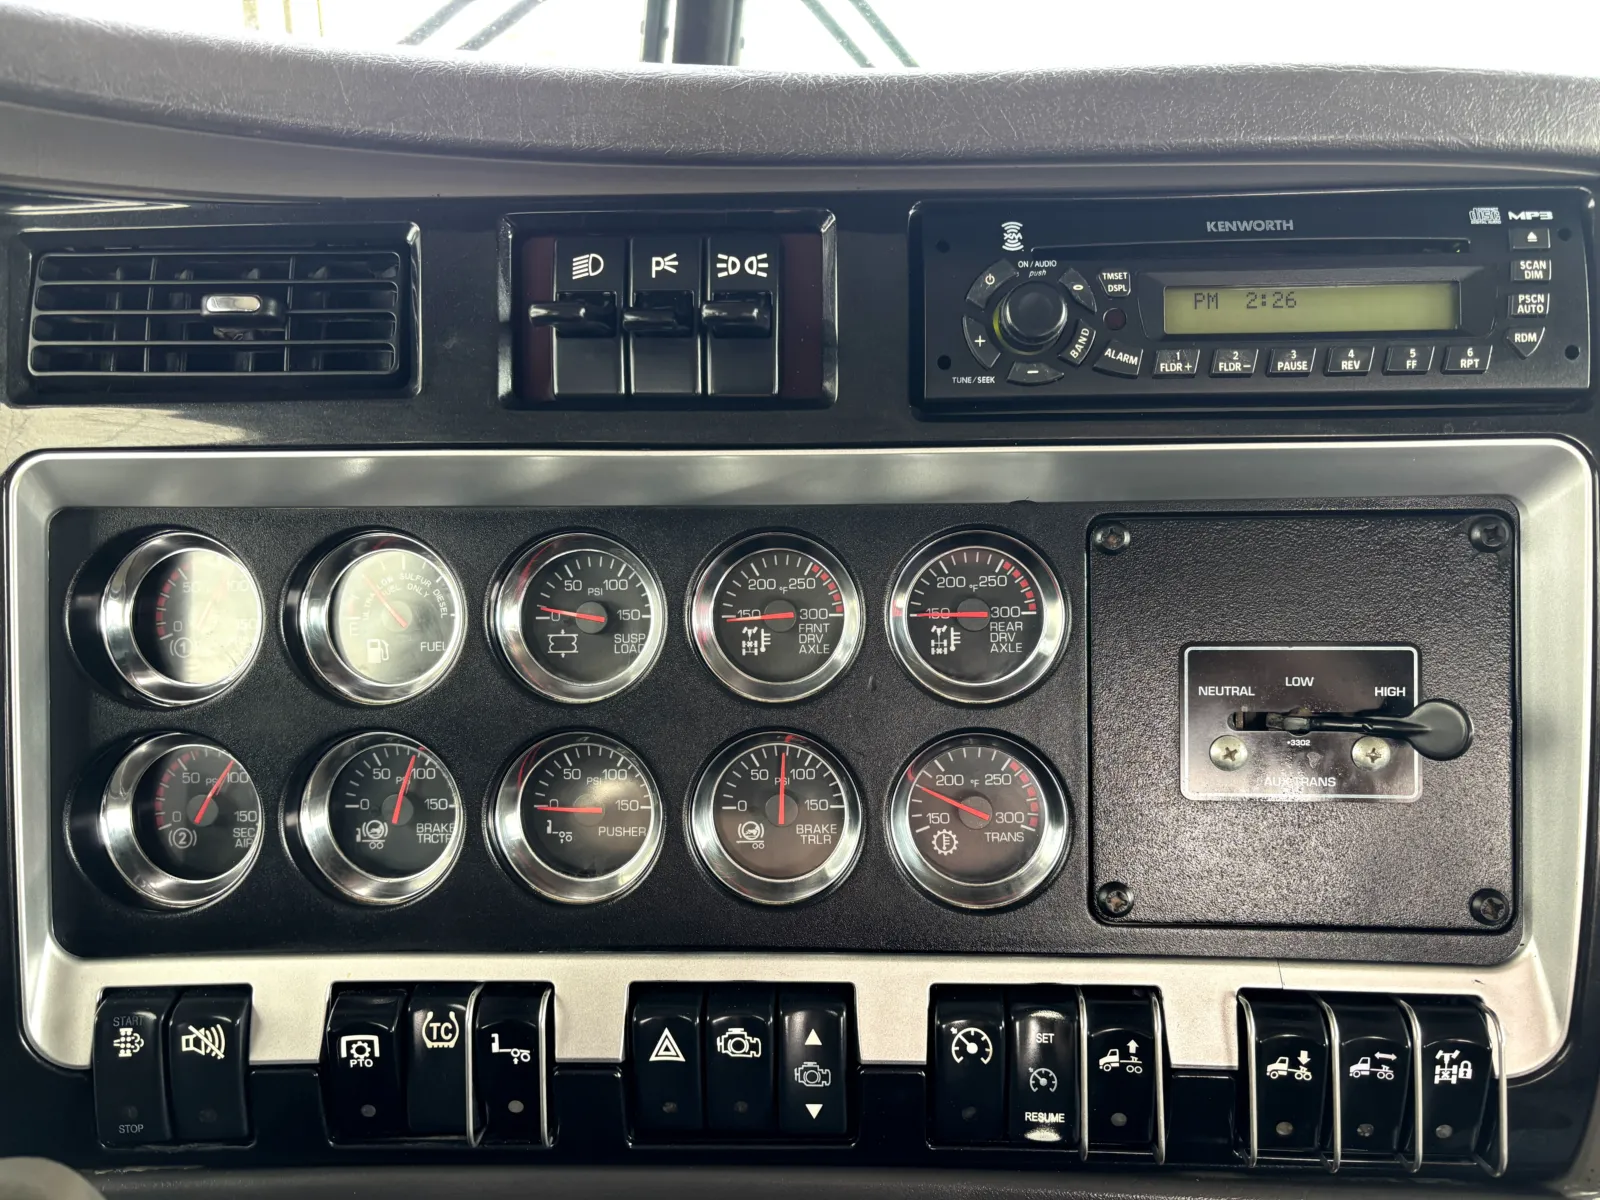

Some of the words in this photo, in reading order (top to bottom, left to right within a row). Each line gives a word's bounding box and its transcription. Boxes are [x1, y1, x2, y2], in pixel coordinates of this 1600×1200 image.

[1508, 211, 1553, 220] MP3
[1206, 219, 1294, 232] KENWORTH
[1017, 260, 1029, 268] ON
[1034, 260, 1057, 268] AUDIO
[1520, 260, 1547, 270] SCAN
[1028, 269, 1047, 278] push
[1102, 272, 1128, 280] TMSET
[1524, 270, 1544, 279] DIM
[1107, 284, 1128, 292] DSPL
[1194, 292, 1219, 310] PM
[1246, 291, 1297, 309] 2:26
[1518, 294, 1545, 303] PSCN
[1517, 304, 1544, 314] AUTO
[1069, 327, 1090, 359] BAND
[1514, 333, 1537, 343] RDM
[1104, 348, 1139, 366] ALARM
[1175, 351, 1181, 360] 1
[1232, 351, 1239, 360] 2
[1290, 350, 1297, 359] 3
[1348, 349, 1355, 358] 4
[1409, 348, 1416, 358] 5
[1467, 348, 1474, 357] 6
[1277, 361, 1308, 371] PAUSE
[1341, 360, 1361, 370] REV
[1406, 360, 1417, 370] FF
[1459, 358, 1480, 369] RPT
[564, 579, 583, 591] 50
[603, 579, 629, 591] 100
[748, 579, 776, 590] 200
[788, 578, 816, 590] 250
[936, 576, 966, 588] 200
[978, 575, 1008, 587] 250
[399, 573, 432, 588] SULFUR
[432, 589, 448, 618] DIESEL
[407, 583, 431, 598] ONLY
[587, 588, 604, 596] PSI
[616, 609, 641, 621] 150
[799, 608, 829, 620] 300
[990, 606, 1021, 618] 300
[798, 623, 830, 633] FRNT
[989, 621, 1023, 632] REAR
[614, 633, 646, 644] SUSP
[798, 634, 824, 644] DRV
[989, 632, 1016, 643] DRV
[420, 641, 447, 652] FUEL
[798, 644, 830, 654] AXLE
[990, 643, 1023, 653] AXLE
[1285, 676, 1315, 687] LOW
[1198, 686, 1255, 697] NEUTRAL
[1374, 686, 1406, 697] HIGH
[182, 772, 200, 784] 50
[226, 771, 249, 783] 100
[372, 768, 391, 780] 50
[411, 767, 436, 780] 100
[563, 768, 582, 780] 50
[602, 768, 628, 781] 100
[750, 768, 769, 781] 50
[789, 768, 816, 780] 100
[586, 776, 602, 785] PSI
[935, 774, 965, 786] 200
[984, 774, 1012, 786] 250
[360, 799, 370, 810] 0
[424, 799, 448, 811] 150
[615, 799, 639, 811] 150
[737, 800, 748, 812] 0
[804, 799, 829, 811] 150
[172, 811, 182, 822] 0
[234, 810, 258, 822] 150
[926, 812, 950, 824] 150
[995, 811, 1025, 824] 300
[232, 827, 256, 838] SEC
[598, 826, 647, 837] PUSHER
[796, 823, 838, 835] BRAKE
[800, 834, 832, 845] TRLR
[984, 832, 1025, 843] TRANS
[113, 1015, 145, 1027] START
[428, 1021, 453, 1041] TC
[1035, 1033, 1055, 1044] SET
[350, 1058, 374, 1068] PTO
[1024, 1111, 1066, 1123] RESUME
[118, 1123, 144, 1135] STOP
